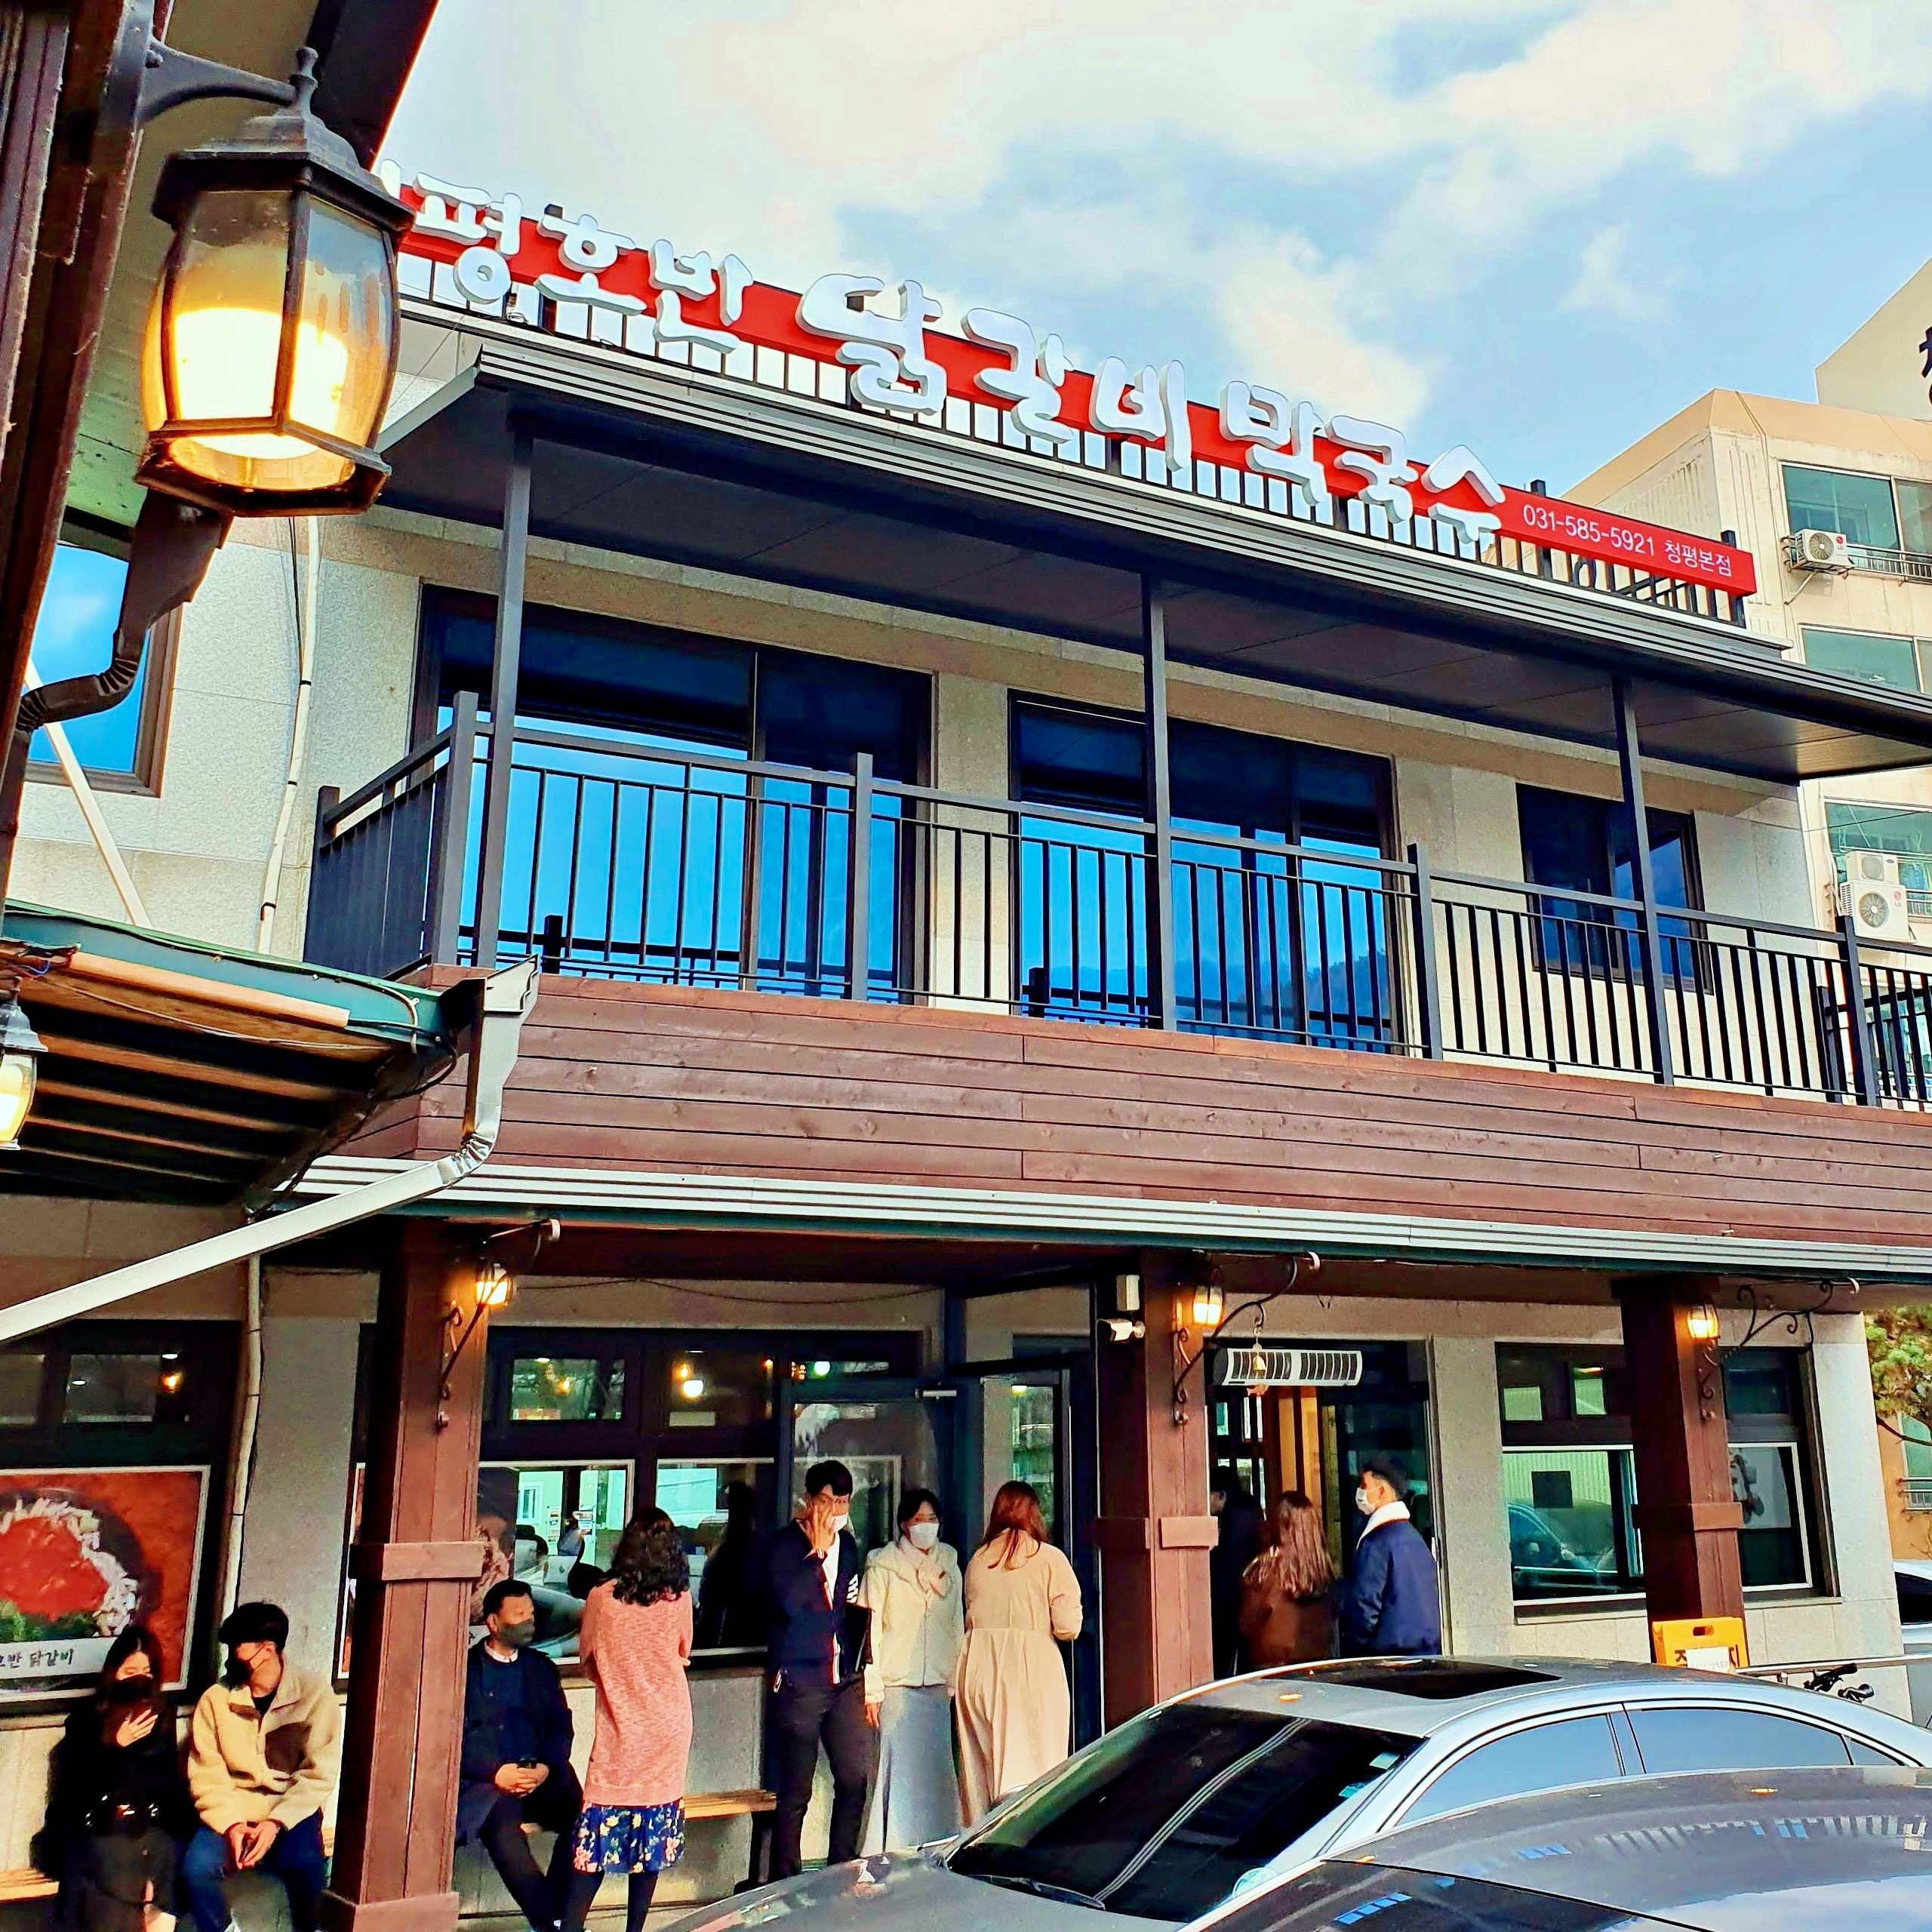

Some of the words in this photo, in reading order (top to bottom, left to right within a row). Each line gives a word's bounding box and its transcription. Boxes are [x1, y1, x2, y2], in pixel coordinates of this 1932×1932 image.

[381, 159, 754, 353] 평호반
[795, 274, 1192, 472] 닭갈비
[1220, 380, 1506, 544] 막국수
[1523, 504, 1654, 557] 031-585-5921
[1664, 540, 1732, 577] 청평본점
